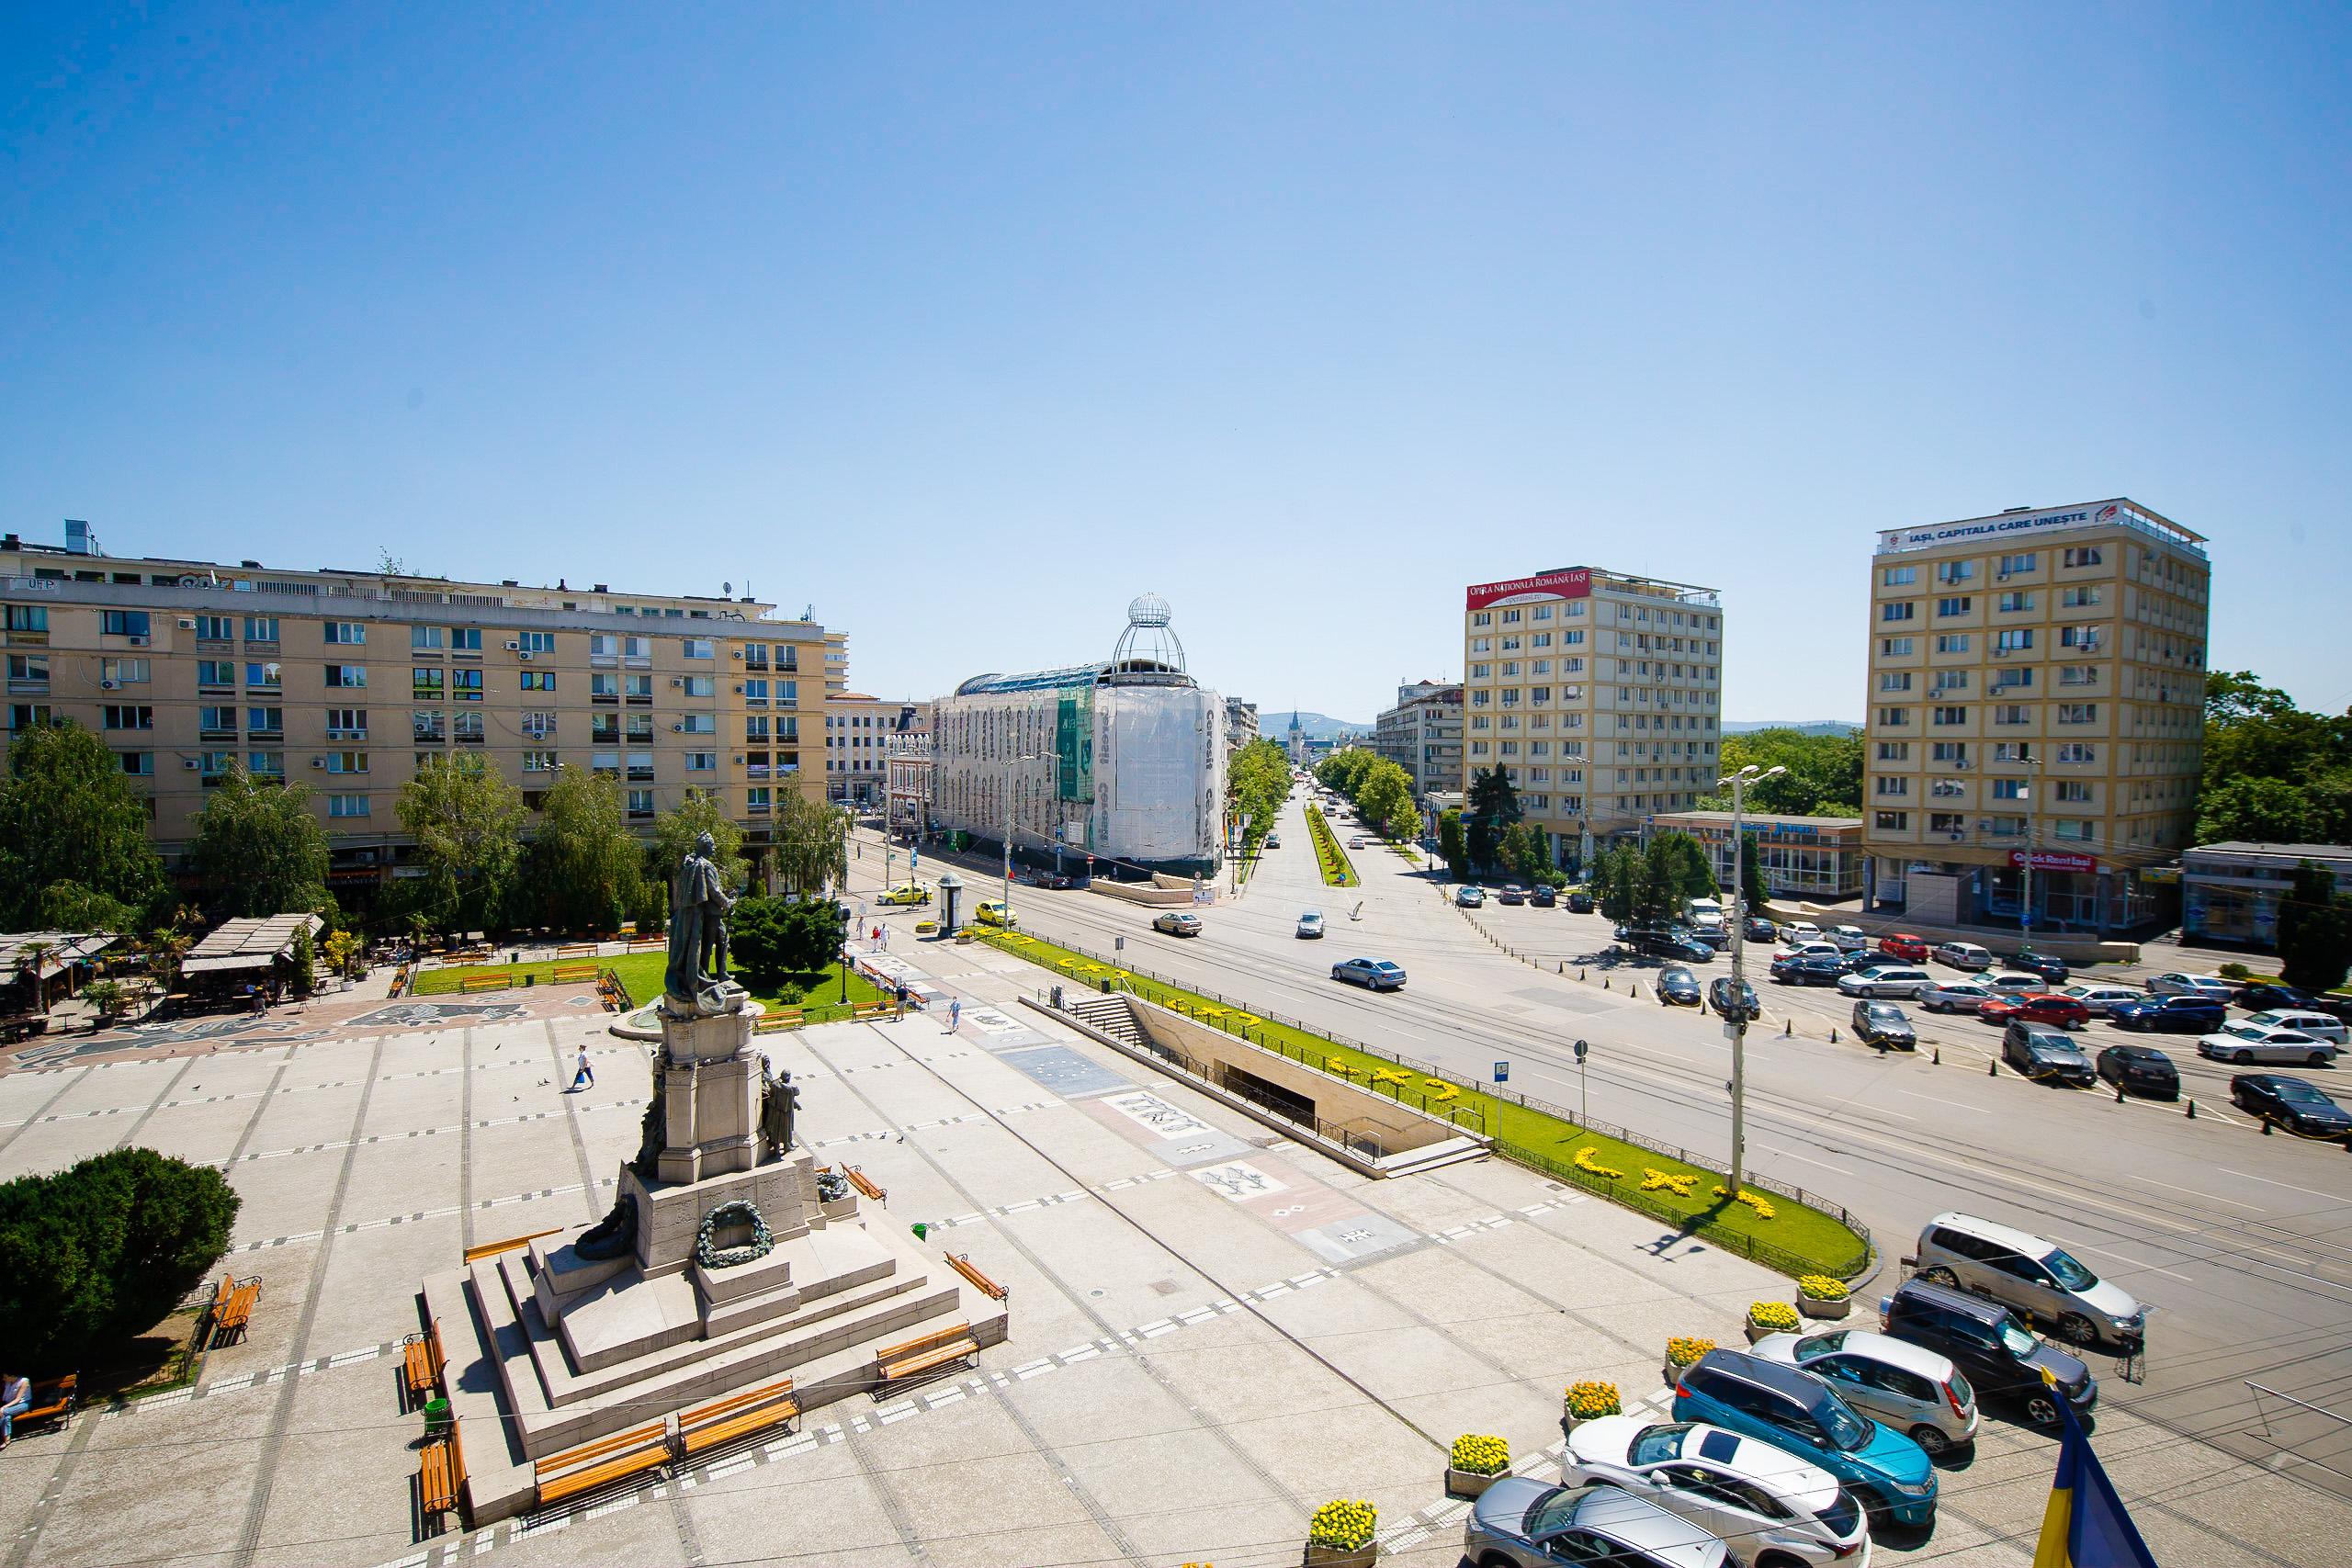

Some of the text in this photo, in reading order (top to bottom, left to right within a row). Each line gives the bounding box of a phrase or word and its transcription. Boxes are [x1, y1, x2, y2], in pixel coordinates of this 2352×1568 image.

[1938, 525, 1996, 538] CAPITALA
[1998, 519, 2031, 531] CARE
[2034, 512, 2087, 526] UNEȘTE
[1205, 709, 1215, 770] Ceresit
